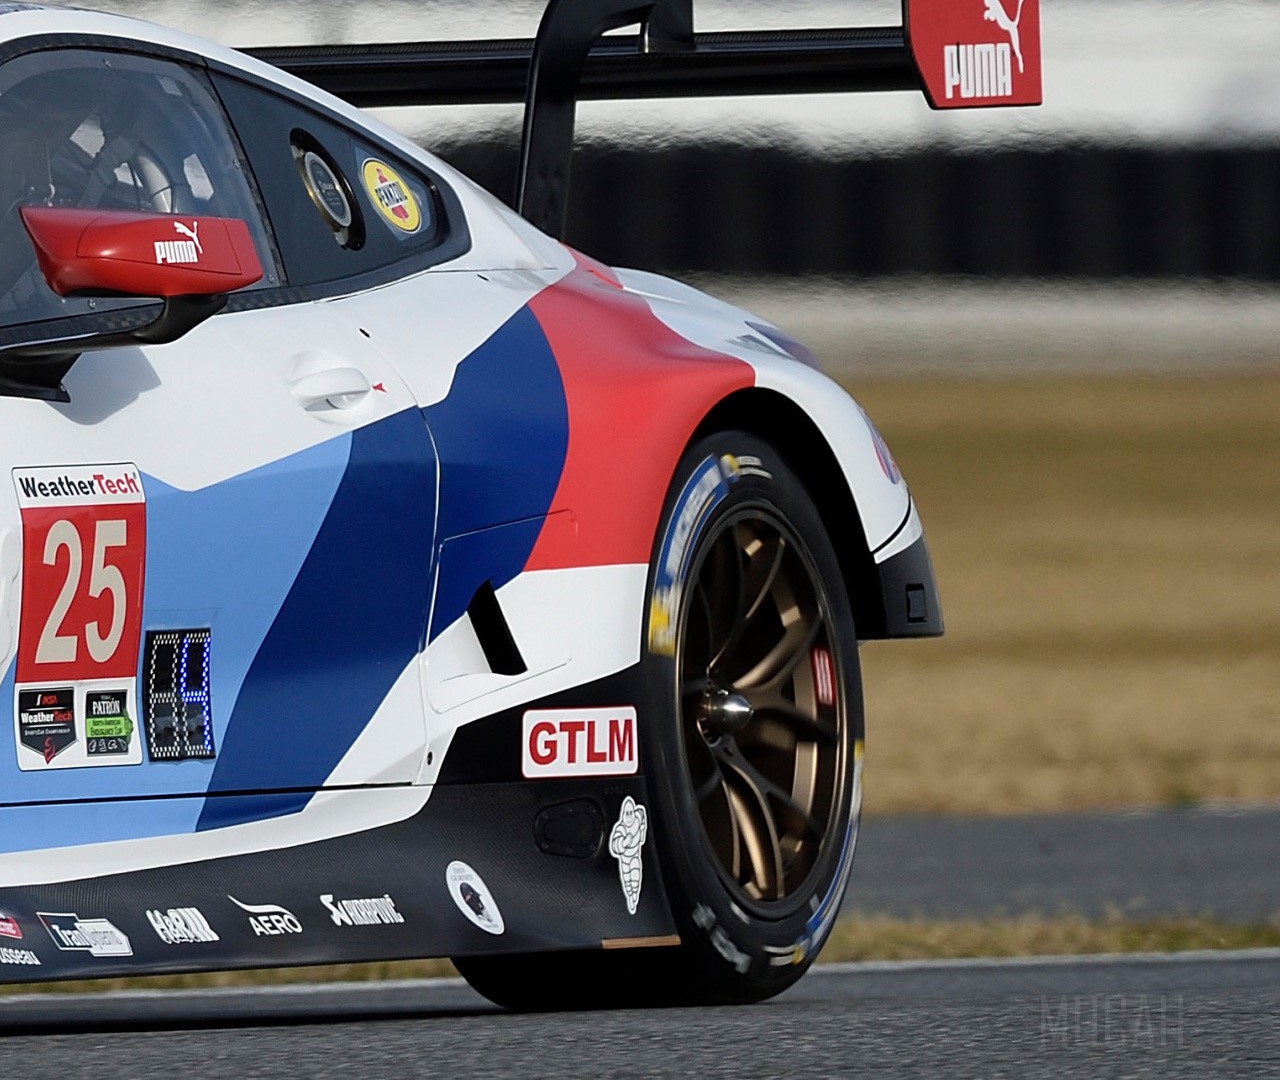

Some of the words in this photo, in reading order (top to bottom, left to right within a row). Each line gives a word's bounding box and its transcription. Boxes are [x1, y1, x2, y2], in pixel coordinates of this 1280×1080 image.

[943, 42, 1013, 99] PUMA
[154, 240, 199, 264] PUMA
[18, 472, 140, 498] WeatherTech
[35, 519, 128, 664] 25
[20, 709, 74, 724] WeatherTech
[528, 718, 634, 766] GTLM
[248, 914, 303, 936] AERO
